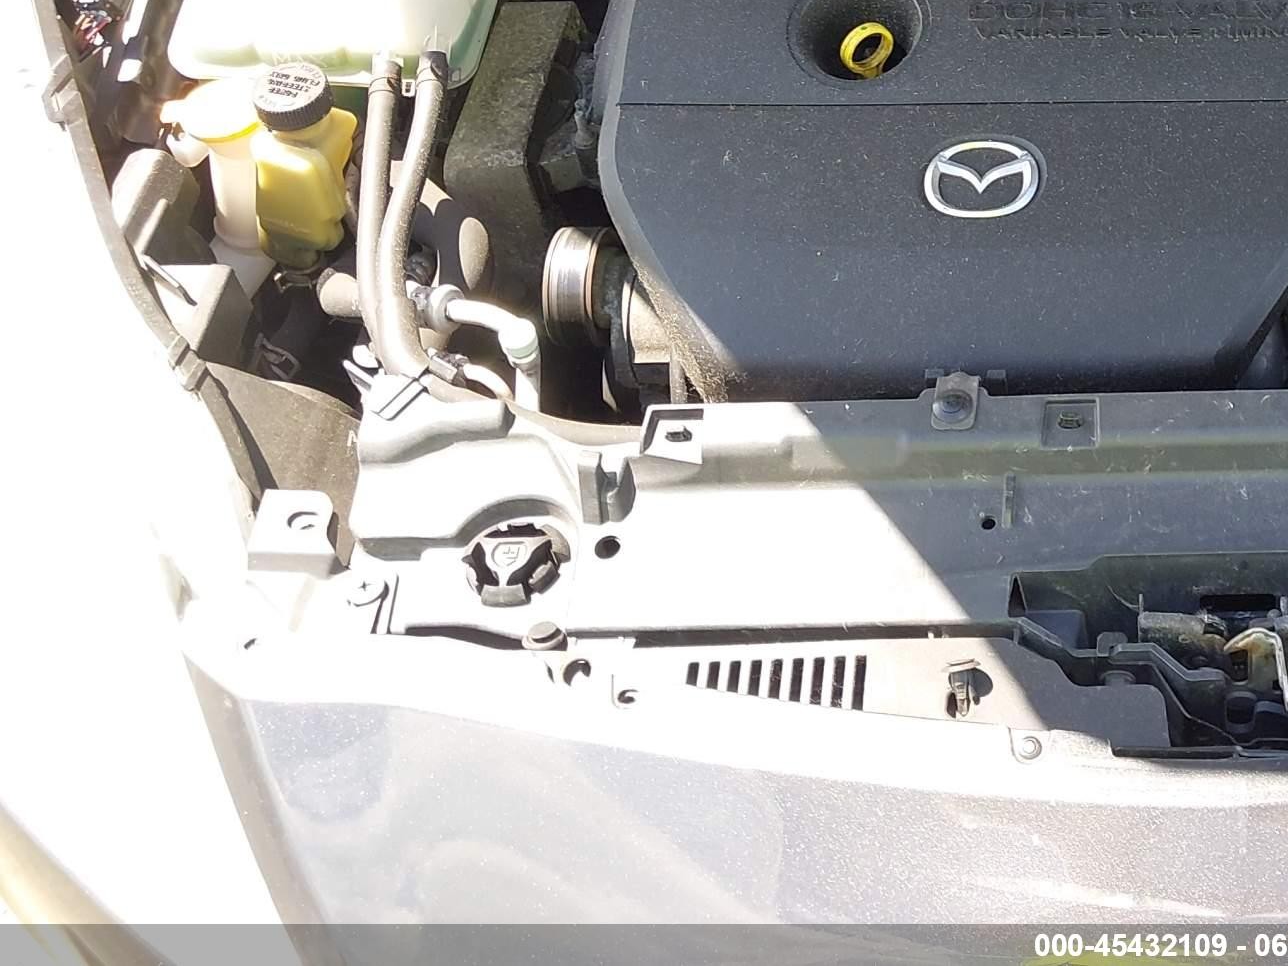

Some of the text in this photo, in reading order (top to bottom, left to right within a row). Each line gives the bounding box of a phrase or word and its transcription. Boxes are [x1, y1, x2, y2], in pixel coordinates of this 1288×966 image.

[967, 1, 1108, 21] DOHC
[974, 25, 1112, 41] VARIABLE
[1118, 25, 1202, 42] VALVE
